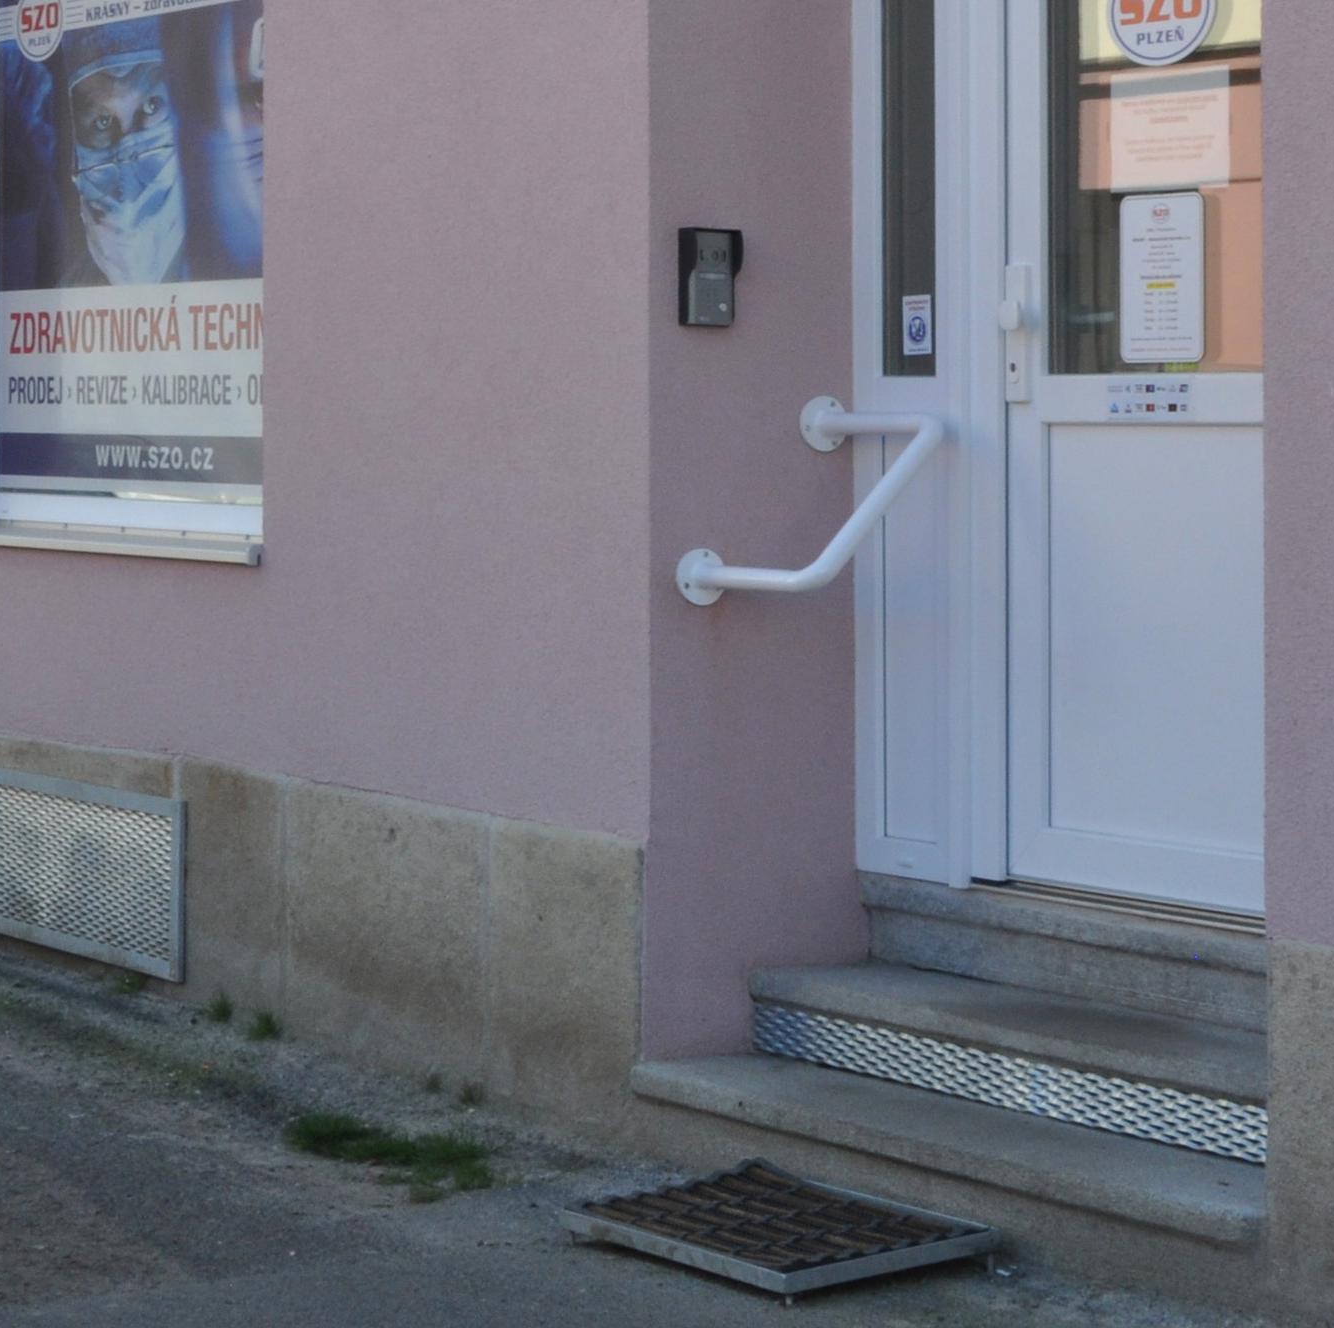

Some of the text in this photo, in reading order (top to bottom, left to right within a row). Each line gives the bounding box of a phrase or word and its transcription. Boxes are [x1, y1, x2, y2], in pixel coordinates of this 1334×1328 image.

[21, 3, 59, 33] SZO
[1136, 25, 1184, 46] PLZEŇ
[10, 295, 181, 355] ZDRAVOTNICKÁ
[8, 375, 63, 404] PRODEJ
[76, 375, 129, 404] REVIZE
[141, 374, 232, 405] KALIBRACE
